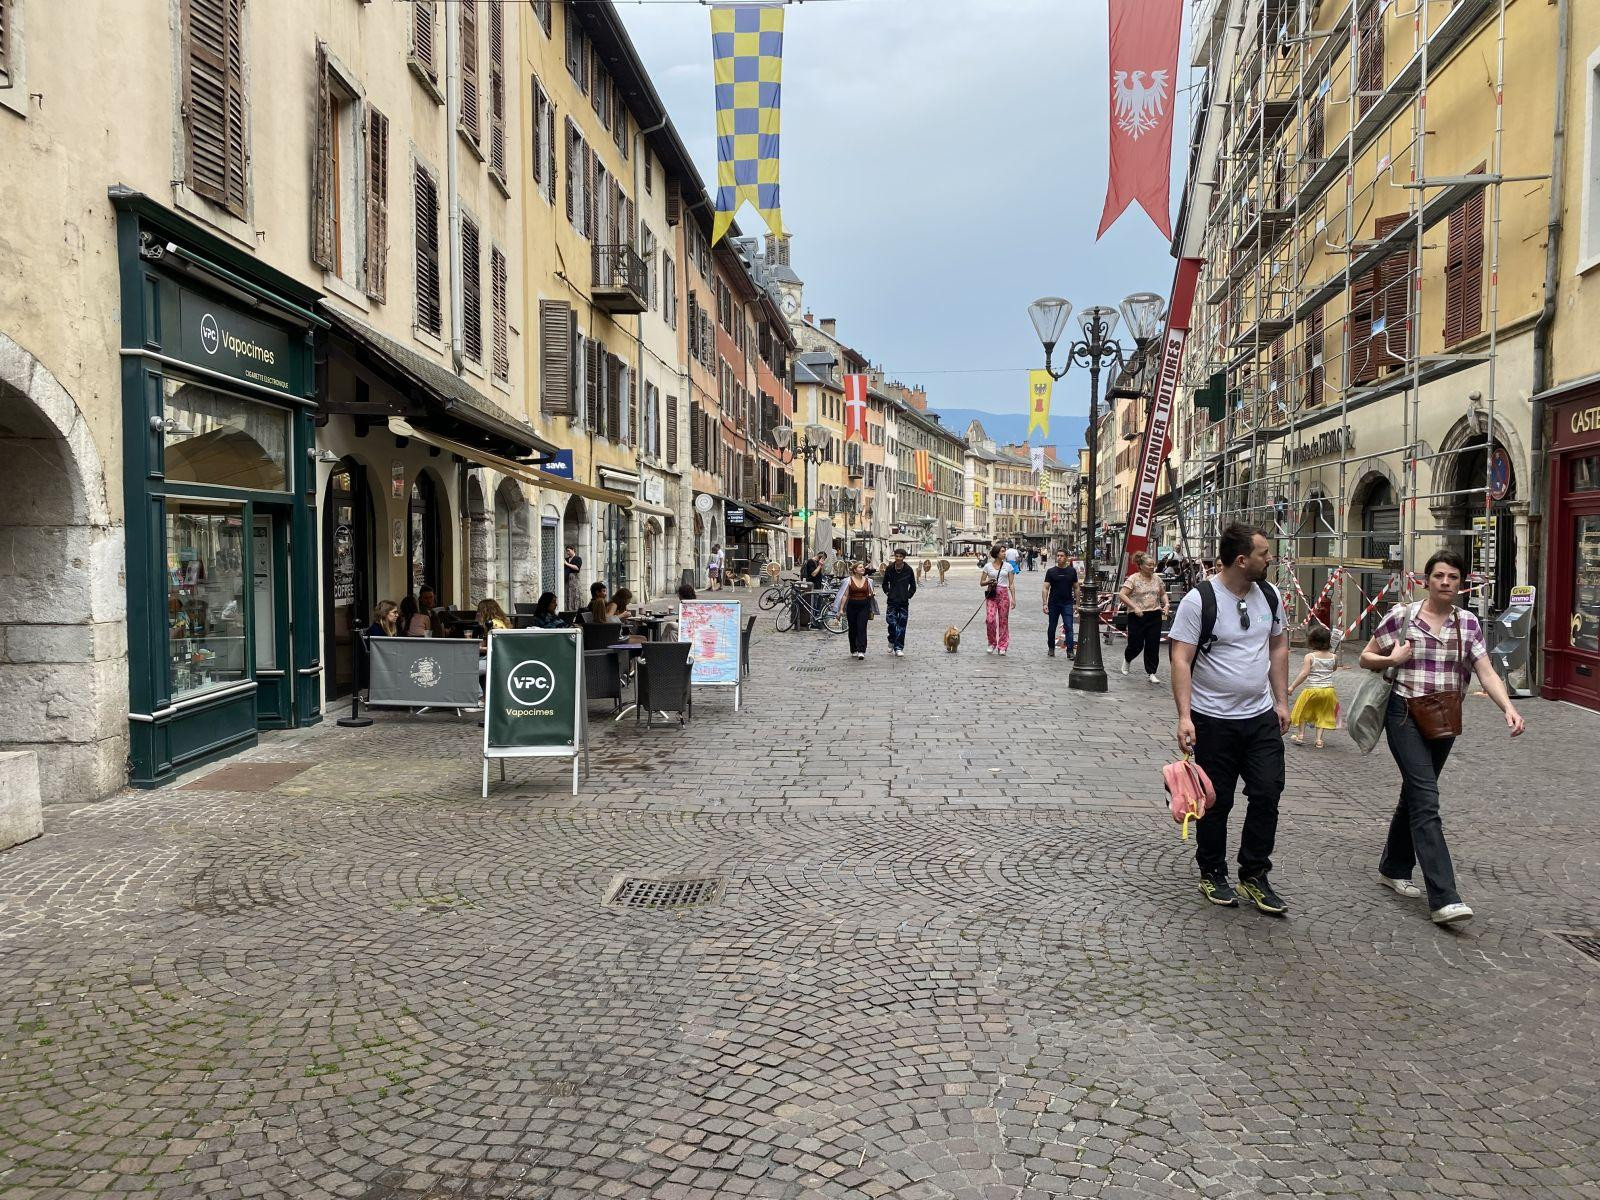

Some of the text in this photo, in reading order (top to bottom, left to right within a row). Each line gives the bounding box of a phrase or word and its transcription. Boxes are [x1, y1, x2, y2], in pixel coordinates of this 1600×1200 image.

[221, 329, 275, 365] Vapocimes
[245, 369, 264, 382] CIGARETTE
[1135, 339, 1181, 528] PAUL VERNIER TOITURES
[334, 583, 354, 598] COFFEE
[505, 708, 554, 718] Vapocimes
